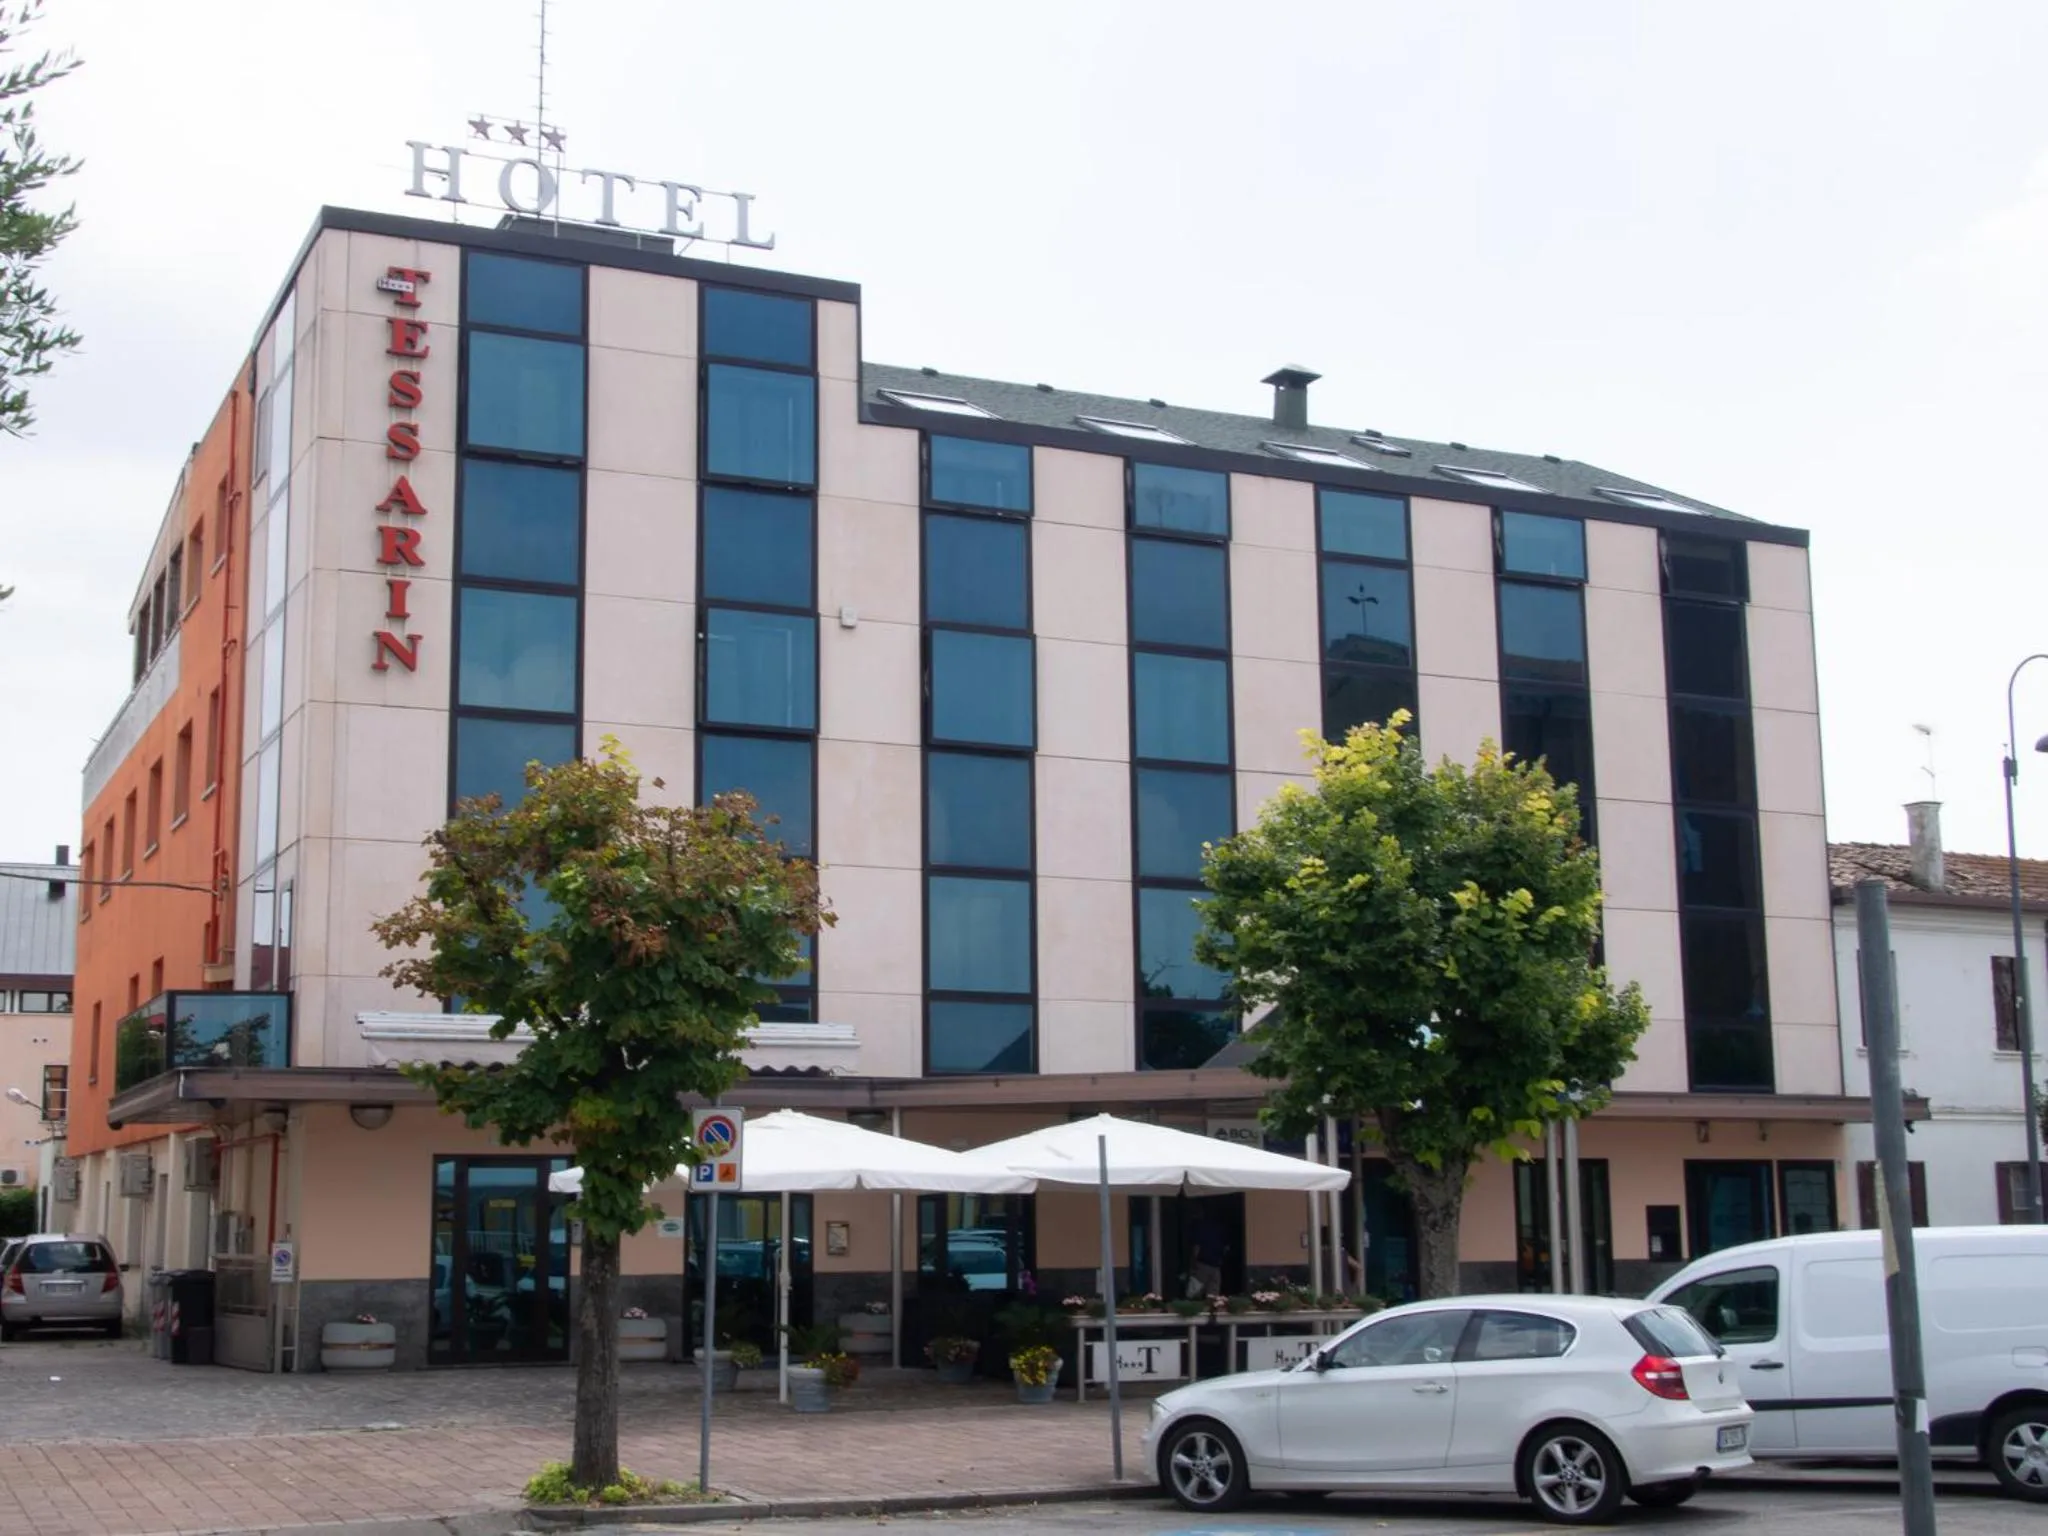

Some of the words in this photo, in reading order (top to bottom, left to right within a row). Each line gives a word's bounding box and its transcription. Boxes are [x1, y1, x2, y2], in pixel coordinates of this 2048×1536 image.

[404, 140, 776, 250] HOTEL
[371, 266, 432, 673] TESSARIN
[700, 1166, 711, 1181] P
[1137, 1346, 1161, 1374] T
